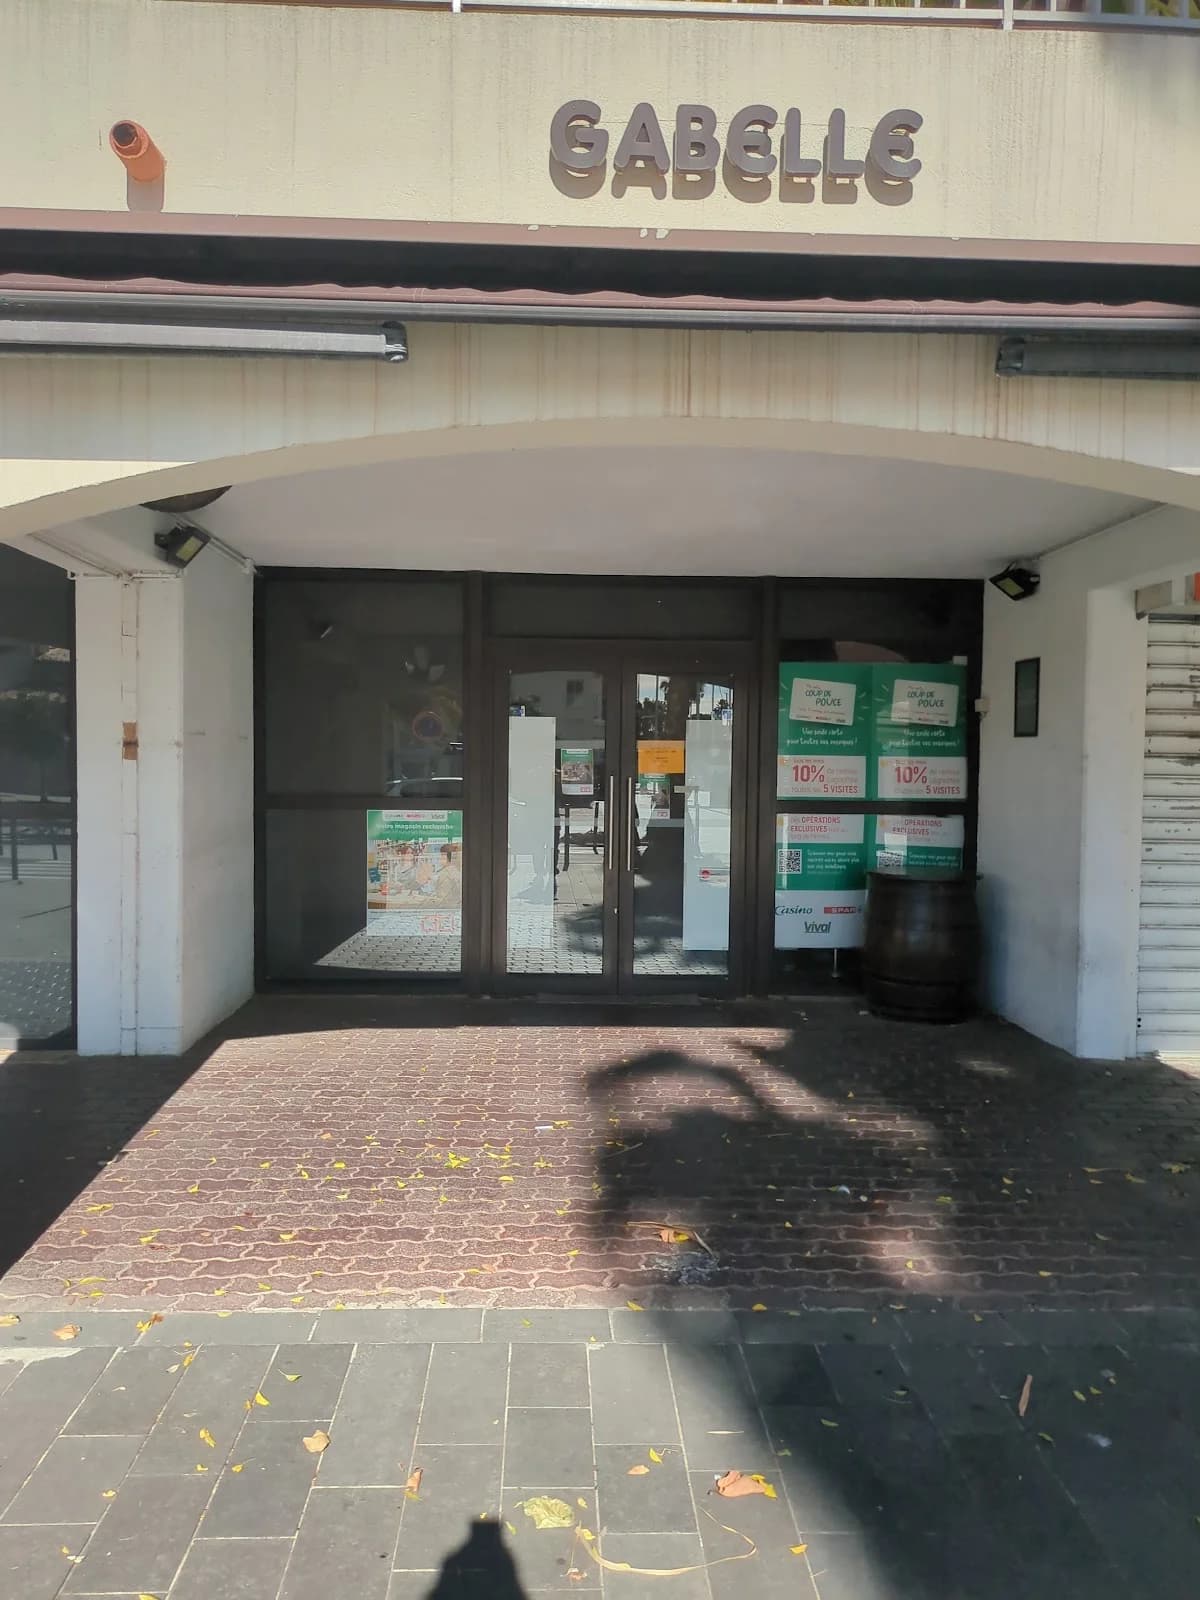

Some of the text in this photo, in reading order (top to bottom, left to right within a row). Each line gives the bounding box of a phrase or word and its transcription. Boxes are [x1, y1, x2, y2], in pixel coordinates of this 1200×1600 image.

[550, 99, 923, 179] GABELLE
[805, 689, 823, 697] COUP
[815, 698, 842, 706] POUCE
[918, 699, 945, 708] POUCE
[792, 764, 825, 783] 10%
[895, 766, 928, 784] 10%
[823, 783, 829, 793] 5
[830, 785, 858, 794] VISITES
[926, 785, 932, 794] 5
[932, 786, 961, 795] VISITES
[790, 825, 827, 833] EXCLUSIVES
[892, 826, 930, 836] EXCLUSIVES
[775, 905, 857, 916] Casino SPAR
[804, 921, 832, 934] Vival
